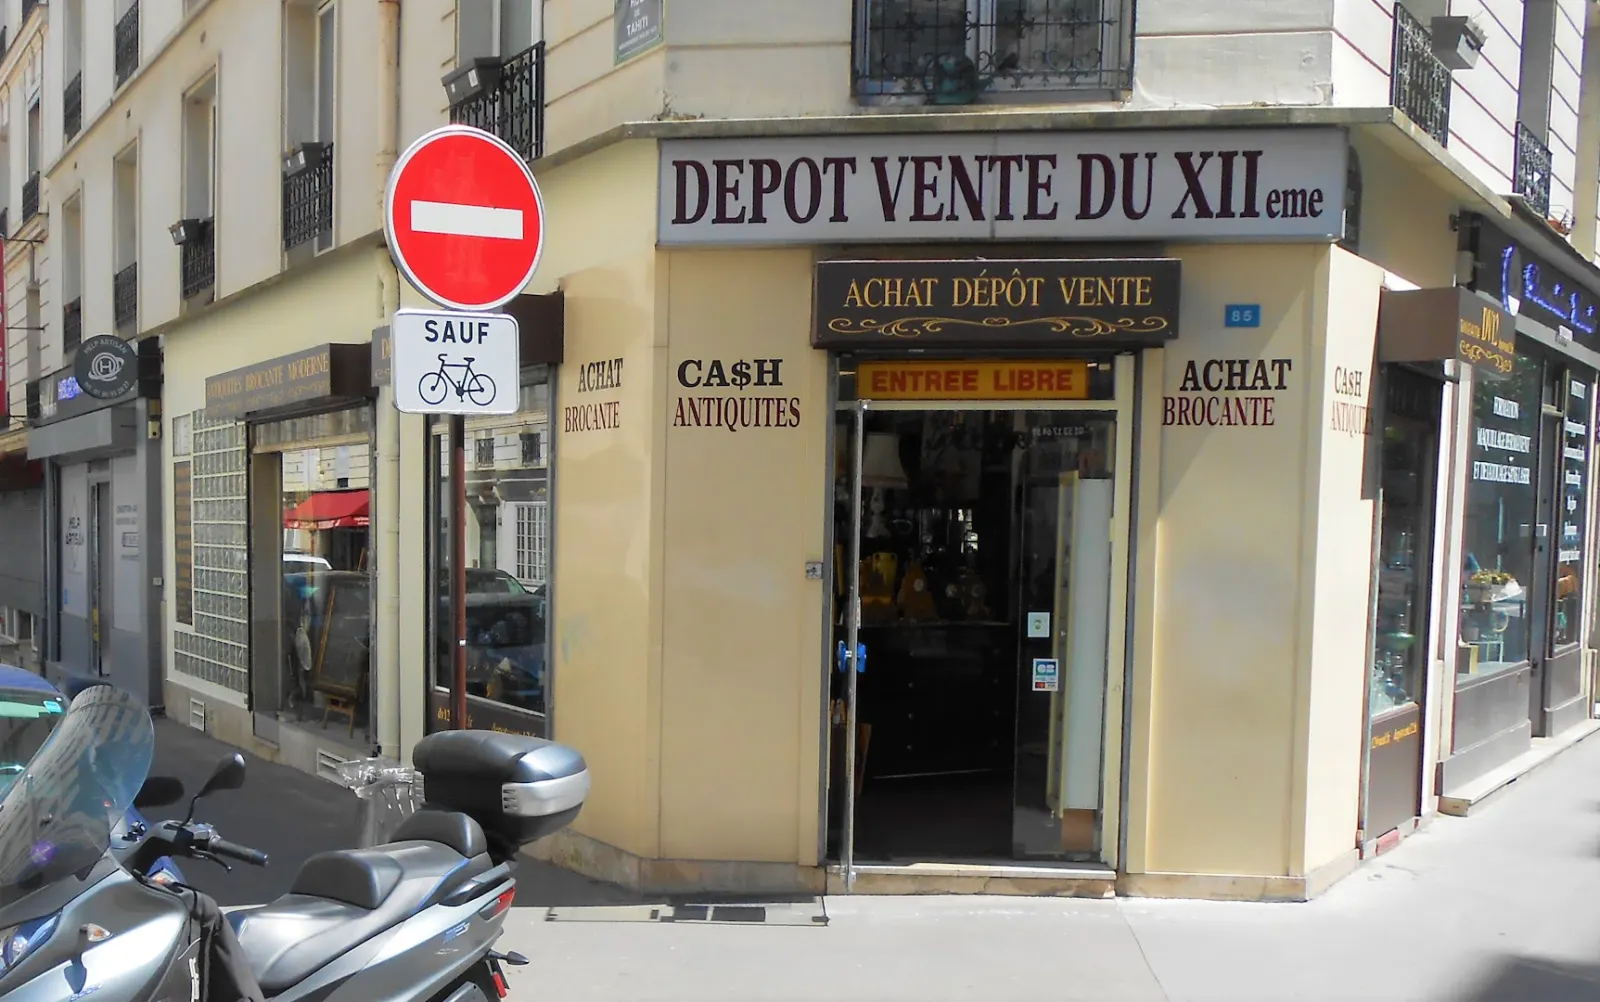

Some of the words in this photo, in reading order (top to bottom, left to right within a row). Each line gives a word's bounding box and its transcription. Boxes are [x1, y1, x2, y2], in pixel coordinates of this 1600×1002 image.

[627, 15, 648, 36] TAHITI
[671, 157, 856, 225] DEPOT
[871, 154, 1059, 222] VENTE
[1075, 152, 1158, 221] DU
[843, 277, 938, 307] ACHAT
[952, 267, 1044, 307] DÉPÔT
[1058, 276, 1153, 307] VENTE
[425, 319, 489, 344] SAUF
[1231, 310, 1252, 322] 85
[287, 352, 329, 381] MODERNE
[577, 358, 623, 393] ACHAT
[677, 359, 783, 391] CA$H
[871, 369, 979, 392] ENTREE
[993, 369, 1073, 392] LIBRE
[1179, 359, 1292, 392] ACHAT
[564, 401, 620, 433] BROCANTE
[673, 397, 801, 433] ANTIQUITES
[1162, 396, 1275, 427] BROCANTE
